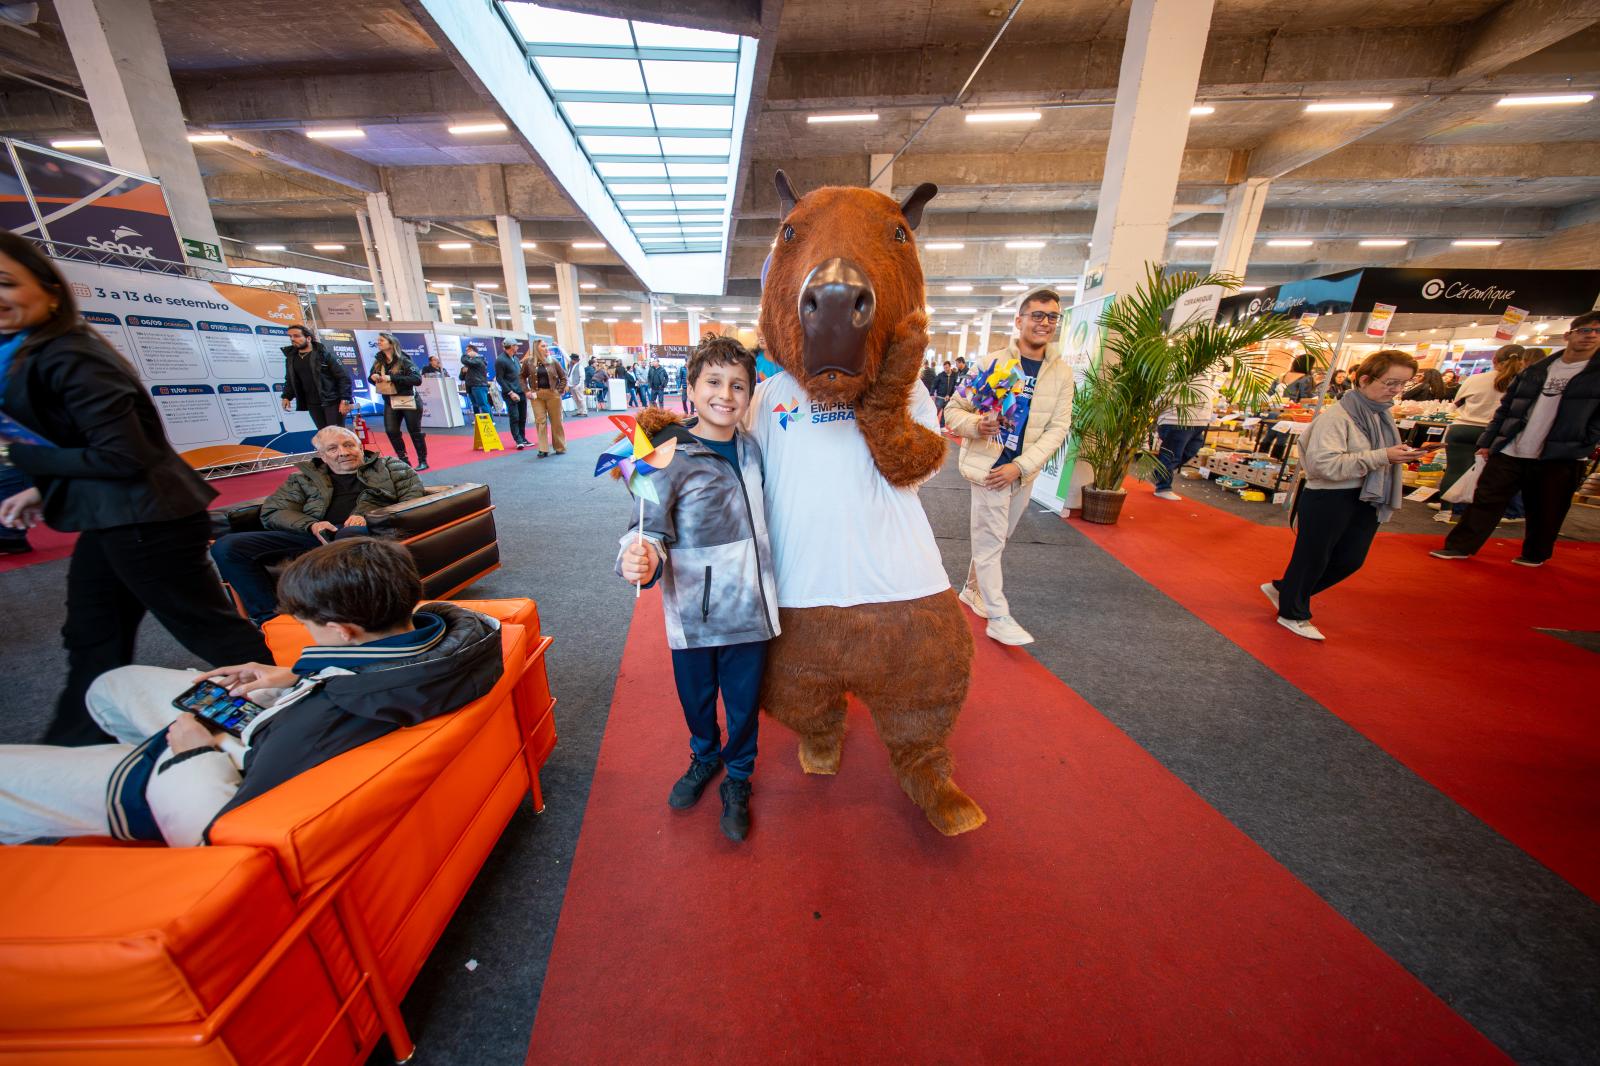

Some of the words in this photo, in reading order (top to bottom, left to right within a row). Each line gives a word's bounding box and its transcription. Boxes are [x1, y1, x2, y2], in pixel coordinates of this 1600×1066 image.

[86, 236, 157, 260] Senac
[94, 287, 106, 298] 3
[111, 291, 121, 300] a
[122, 290, 140, 302] 13
[143, 293, 163, 304] de
[166, 296, 230, 311] setembro
[141, 319, 163, 327] 06/09
[810, 400, 854, 413] EMPRE
[811, 411, 856, 424] SEBRA
